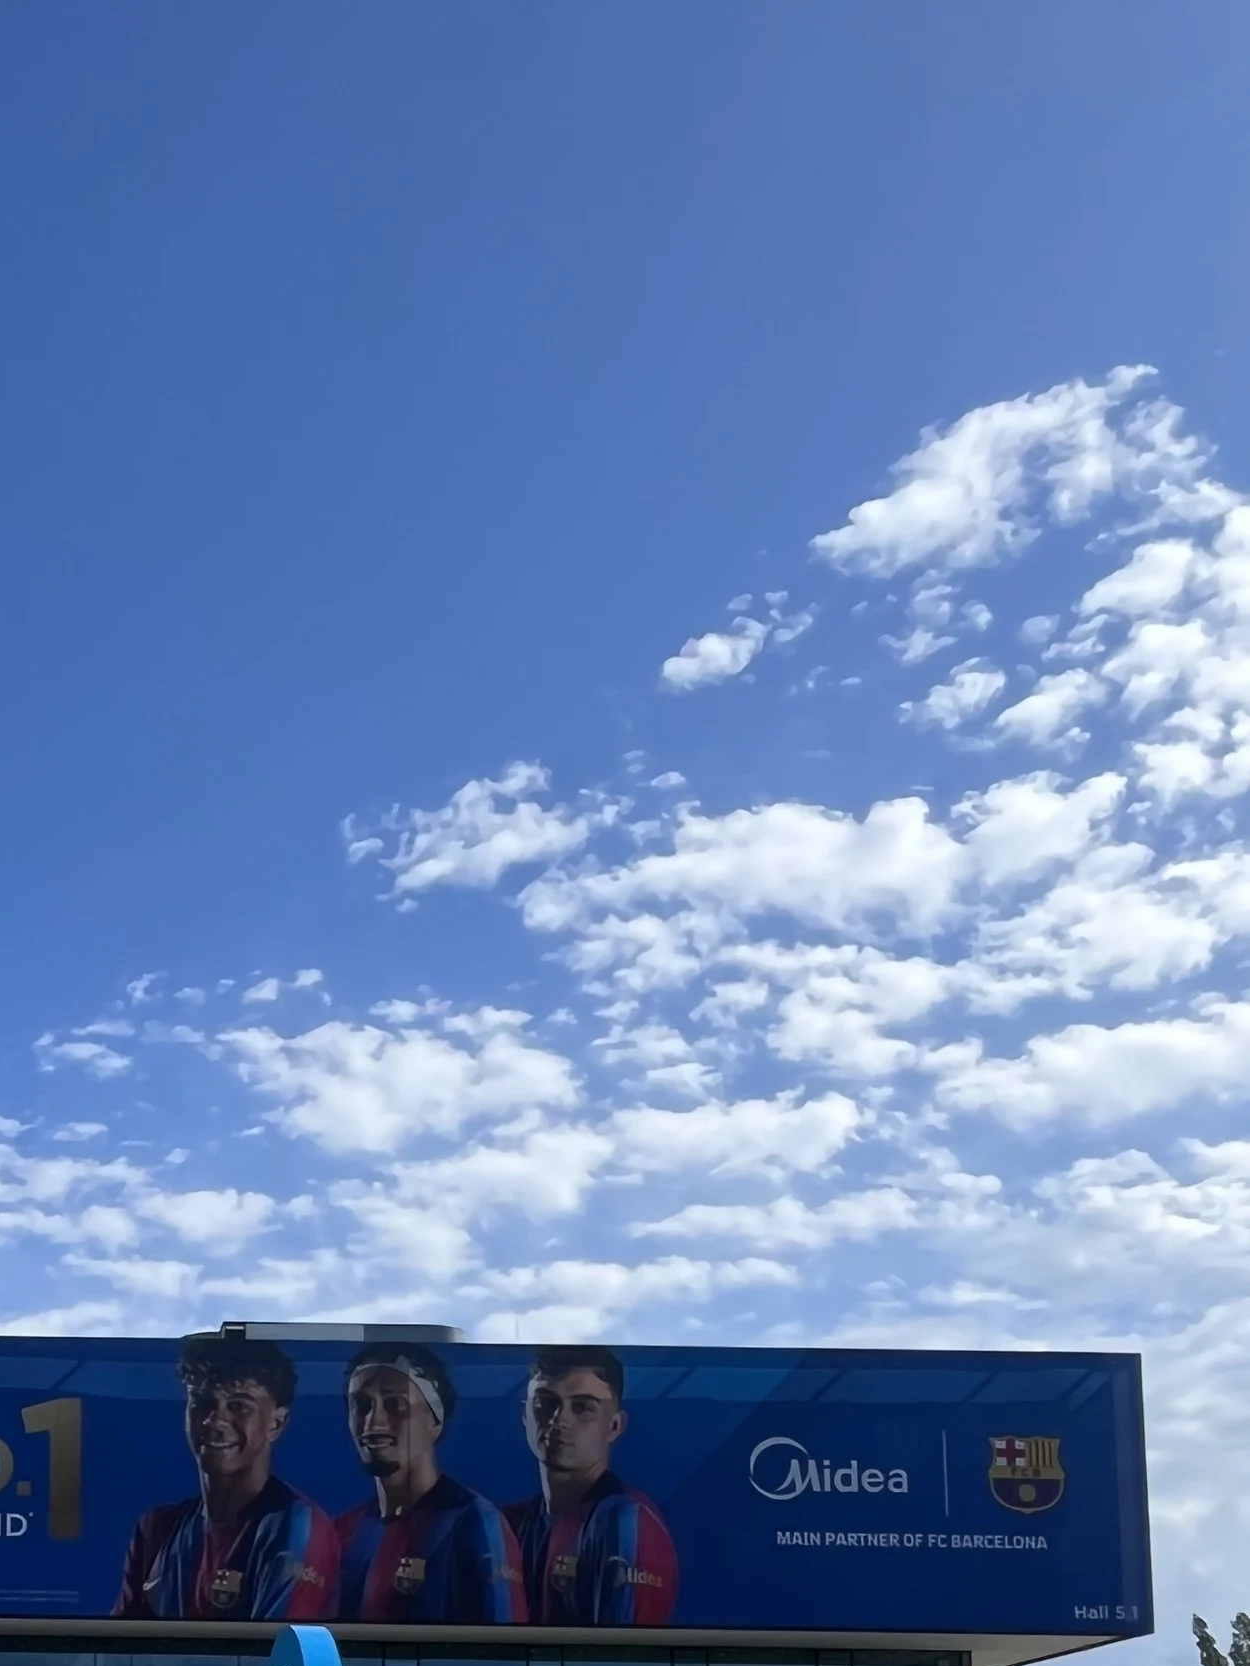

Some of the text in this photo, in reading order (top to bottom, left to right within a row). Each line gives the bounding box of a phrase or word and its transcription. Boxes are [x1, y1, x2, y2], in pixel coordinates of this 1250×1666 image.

[749, 1436, 908, 1501] Midea
[776, 1531, 1048, 1549] MAIN PARTNER OF FC BARCELONA
[1074, 1605, 1109, 1620] Hall
